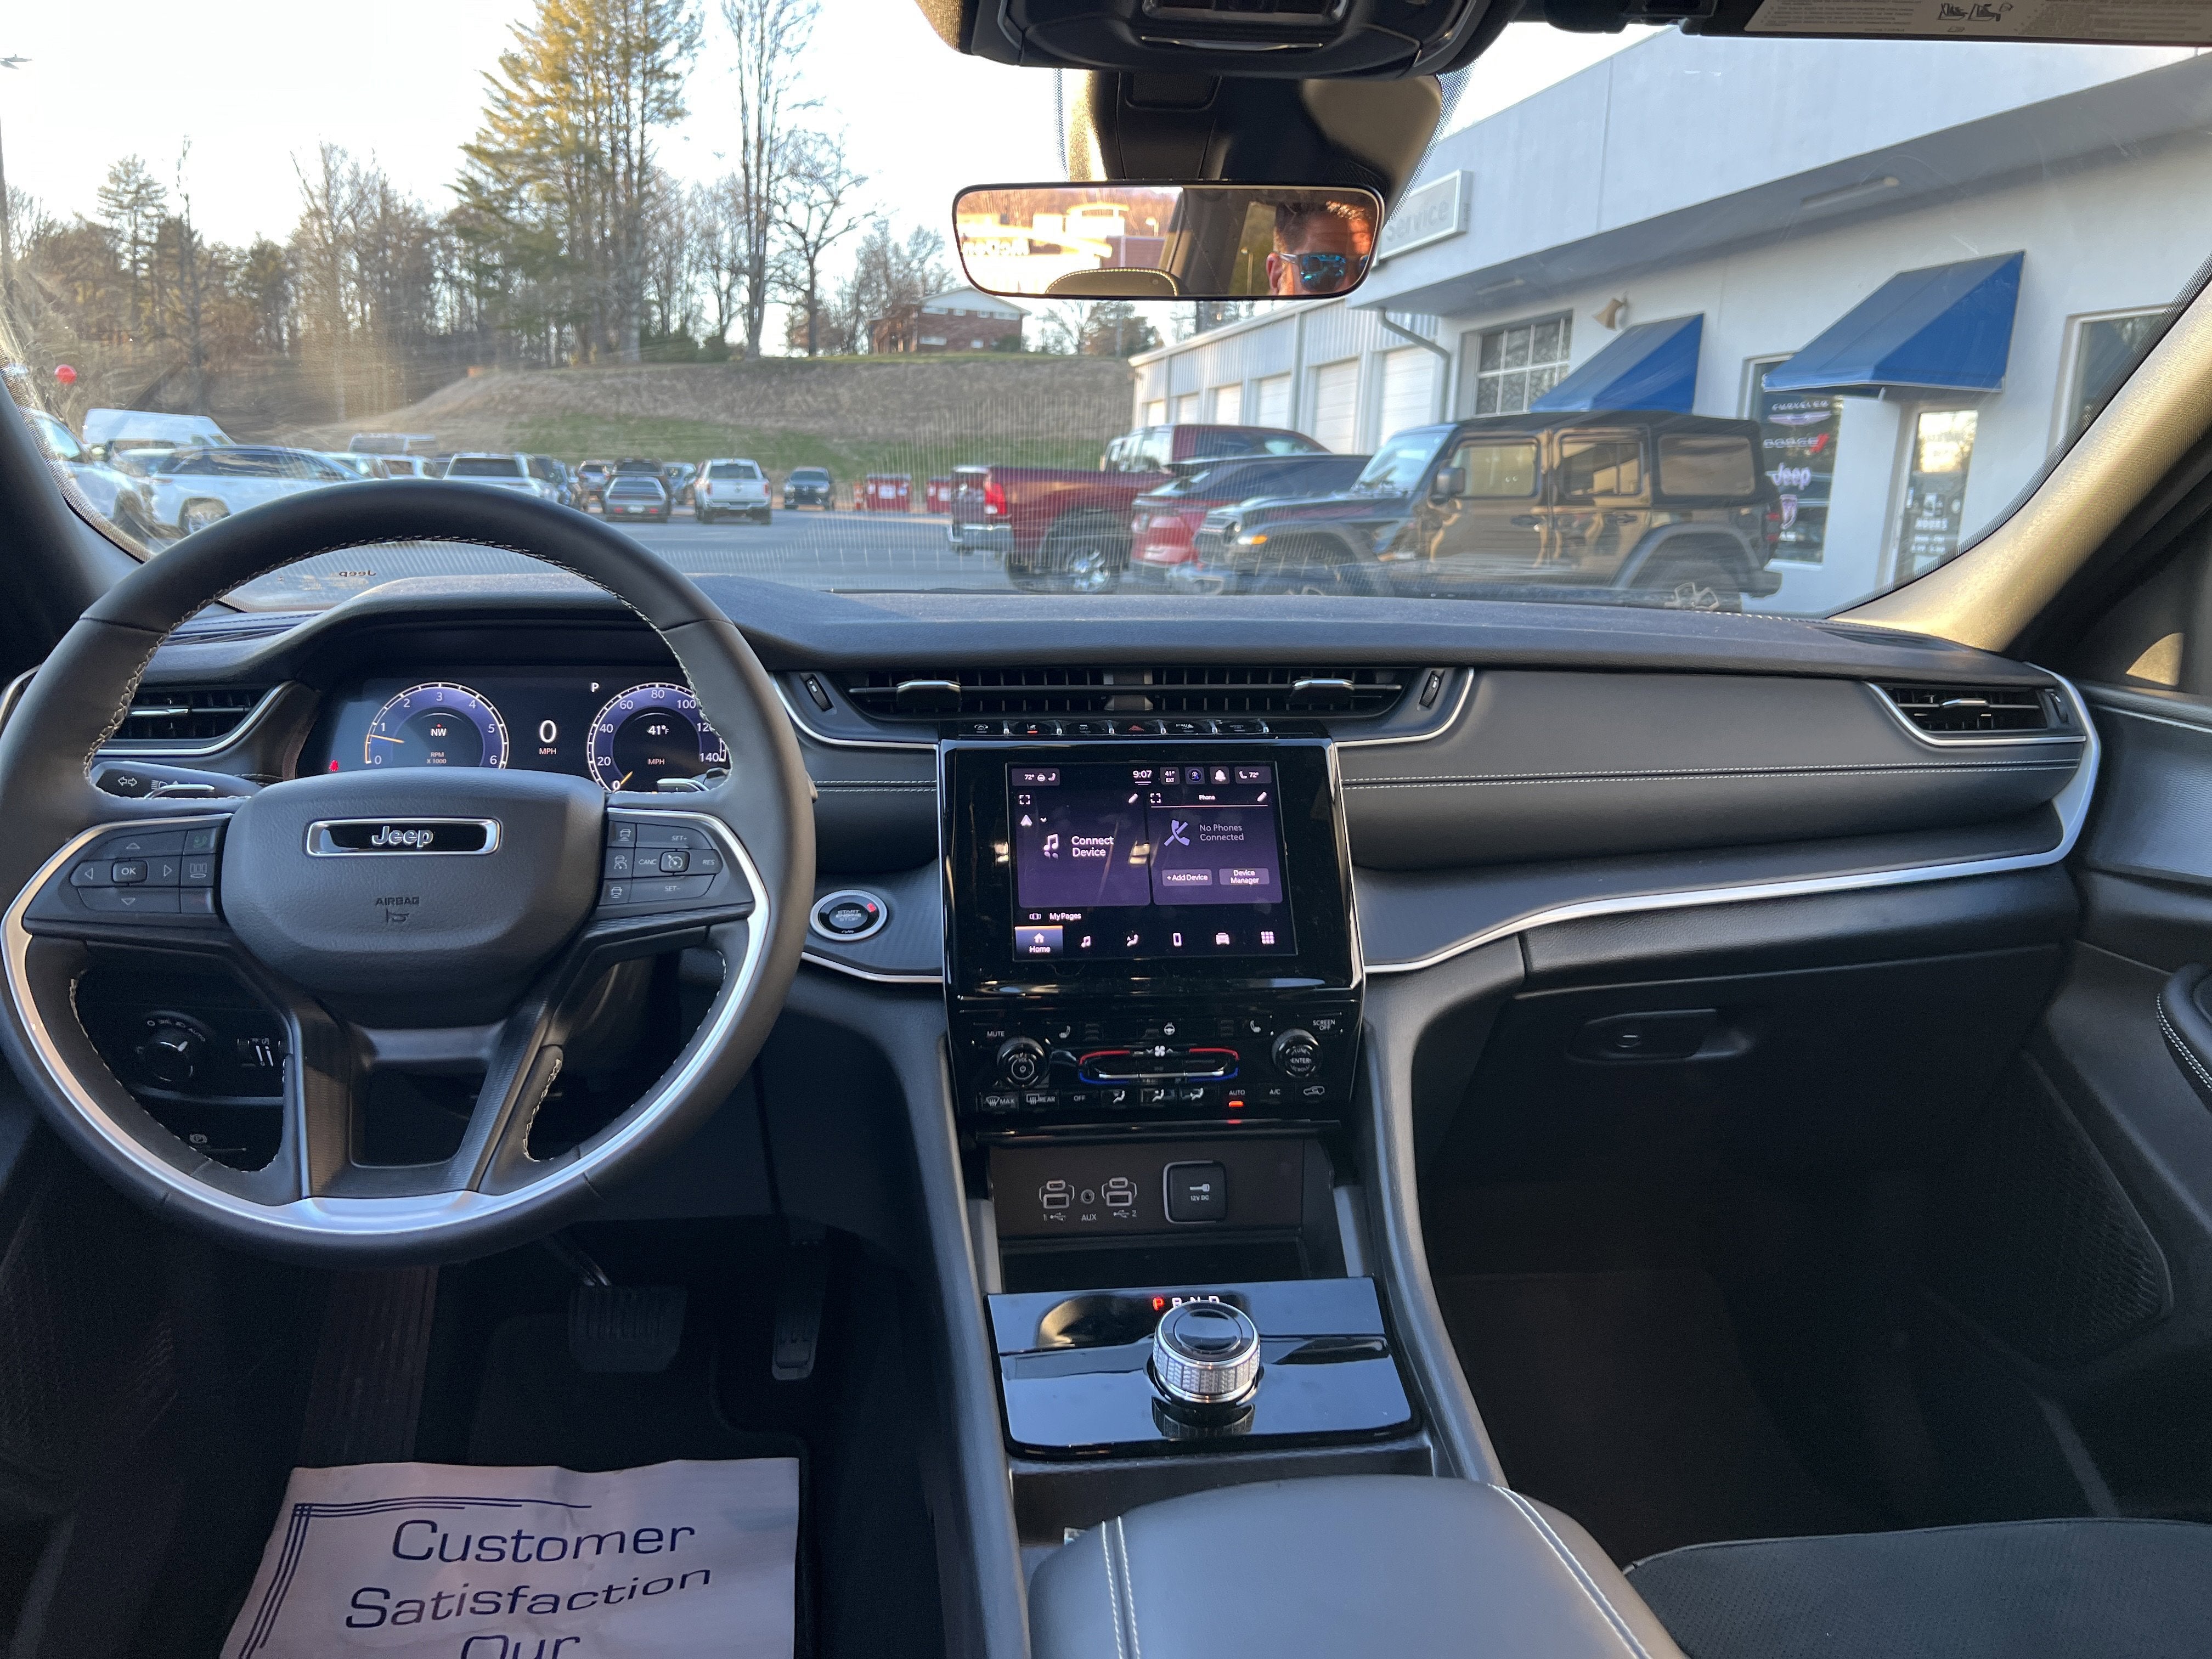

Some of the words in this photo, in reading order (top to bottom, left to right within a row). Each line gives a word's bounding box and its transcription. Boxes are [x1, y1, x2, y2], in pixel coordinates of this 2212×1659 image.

[1771, 462, 1812, 490] Jeep
[591, 682, 599, 692] P
[436, 692, 443, 701] 3
[651, 689, 665, 698] 80
[403, 698, 410, 708] 2
[469, 699, 476, 708] 4
[619, 700, 634, 709] 60
[677, 699, 696, 709] 100
[381, 723, 386, 731] 1
[488, 724, 495, 733] 5
[539, 720, 557, 743] 0
[600, 724, 613, 733] 40
[697, 722, 712, 732] 12
[431, 728, 447, 736] NW
[375, 755, 382, 764] 0
[490, 755, 497, 765] 6
[597, 757, 611, 766] 20
[699, 753, 719, 762] 140
[1133, 770, 1152, 778] 9:07
[612, 780, 620, 791] 0
[1213, 823, 1243, 832] Phones
[371, 825, 434, 849] Jeep
[1071, 835, 1114, 845] Connect
[1200, 833, 1244, 842] Connected
[1072, 848, 1106, 857] Device
[375, 896, 420, 906] AIRBAG
[1153, 1297, 1165, 1311] P
[392, 1520, 696, 1564] Customer
[346, 1568, 712, 1629] Satisfaction
[460, 1634, 581, 1659] Our
